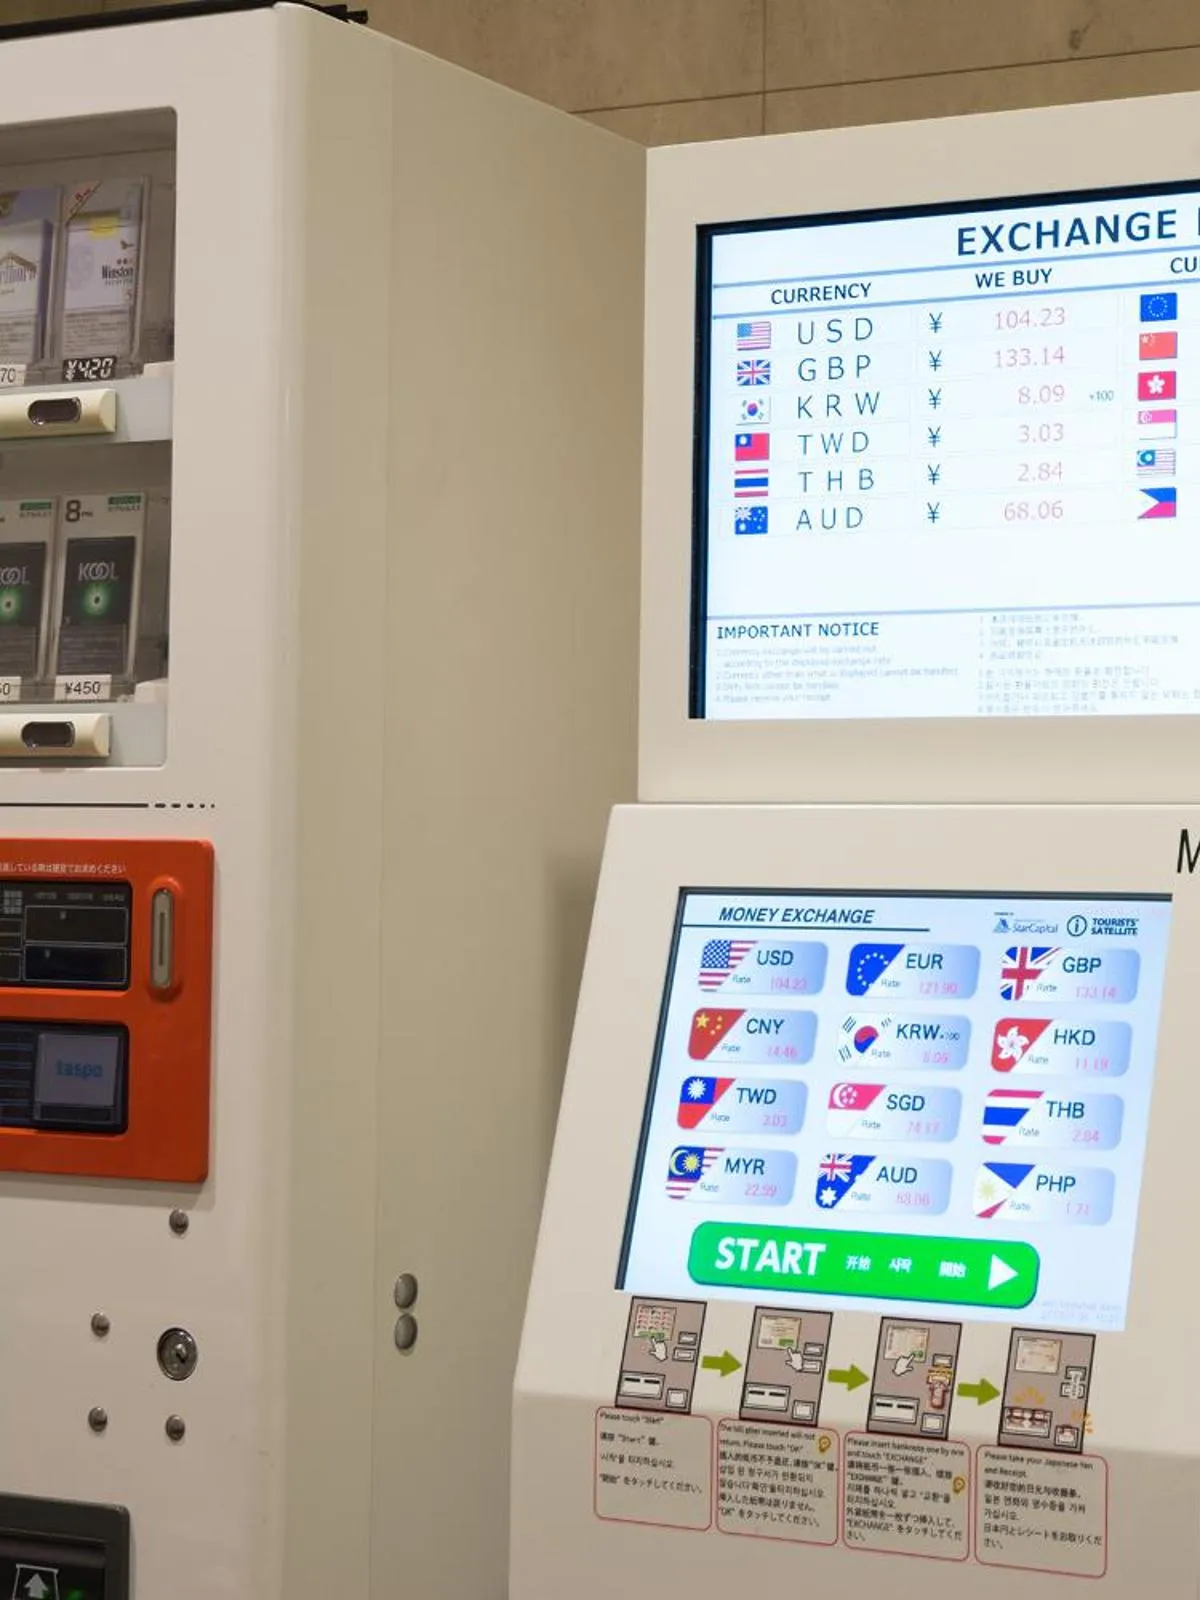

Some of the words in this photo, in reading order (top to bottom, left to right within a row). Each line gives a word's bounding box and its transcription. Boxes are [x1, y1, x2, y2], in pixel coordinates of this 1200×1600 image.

[957, 209, 1177, 256] EXCHANGE
[771, 282, 872, 304] CURRENCY
[975, 271, 1005, 290] WE
[1012, 268, 1052, 286] BUY
[797, 317, 874, 345] USD
[994, 307, 1066, 331] 104.23
[64, 358, 113, 381] ¥420
[798, 354, 872, 382] GBP
[995, 345, 1065, 369] 133.14
[798, 391, 880, 419] KRW
[1018, 385, 1065, 405] 8.09
[798, 431, 870, 456] TWD
[1018, 423, 1064, 444] 3.03
[798, 467, 874, 493] THB
[1017, 461, 1063, 482] 2.84
[65, 500, 81, 522] 8
[796, 505, 863, 531] AUD
[1004, 499, 1064, 522] 68.06
[78, 562, 118, 582] KOOL
[717, 624, 813, 639] IMPORTANT
[818, 622, 880, 637] NOTICE
[64, 680, 101, 696] ¥450
[719, 907, 778, 922] MONEY
[781, 908, 875, 924] EXCHANGE
[1091, 926, 1138, 936] SATELLITE
[756, 950, 794, 966] USD
[907, 953, 943, 970] EUR
[1062, 957, 1102, 973] GBP
[746, 1018, 785, 1034] CNY
[896, 1024, 940, 1040] KRW
[1053, 1029, 1096, 1046] HKD
[55, 1059, 103, 1080] taspo
[736, 1088, 777, 1104] TWD
[887, 1095, 925, 1111] SGD
[1046, 1101, 1085, 1119] THB
[725, 1158, 765, 1175] MYR
[876, 1167, 917, 1183] AUD
[1036, 1175, 1076, 1193] PHP
[715, 1237, 826, 1276] START
[846, 1254, 871, 1271] 开始
[600, 1411, 620, 1420] Please
[622, 1414, 640, 1422] touch
[744, 1440, 765, 1449] Please
[766, 1442, 784, 1450] touch
[848, 1438, 869, 1446] Please
[941, 1447, 949, 1456] by
[985, 1451, 1007, 1460] Please
[1009, 1453, 1024, 1462] take
[1027, 1457, 1042, 1465] your
